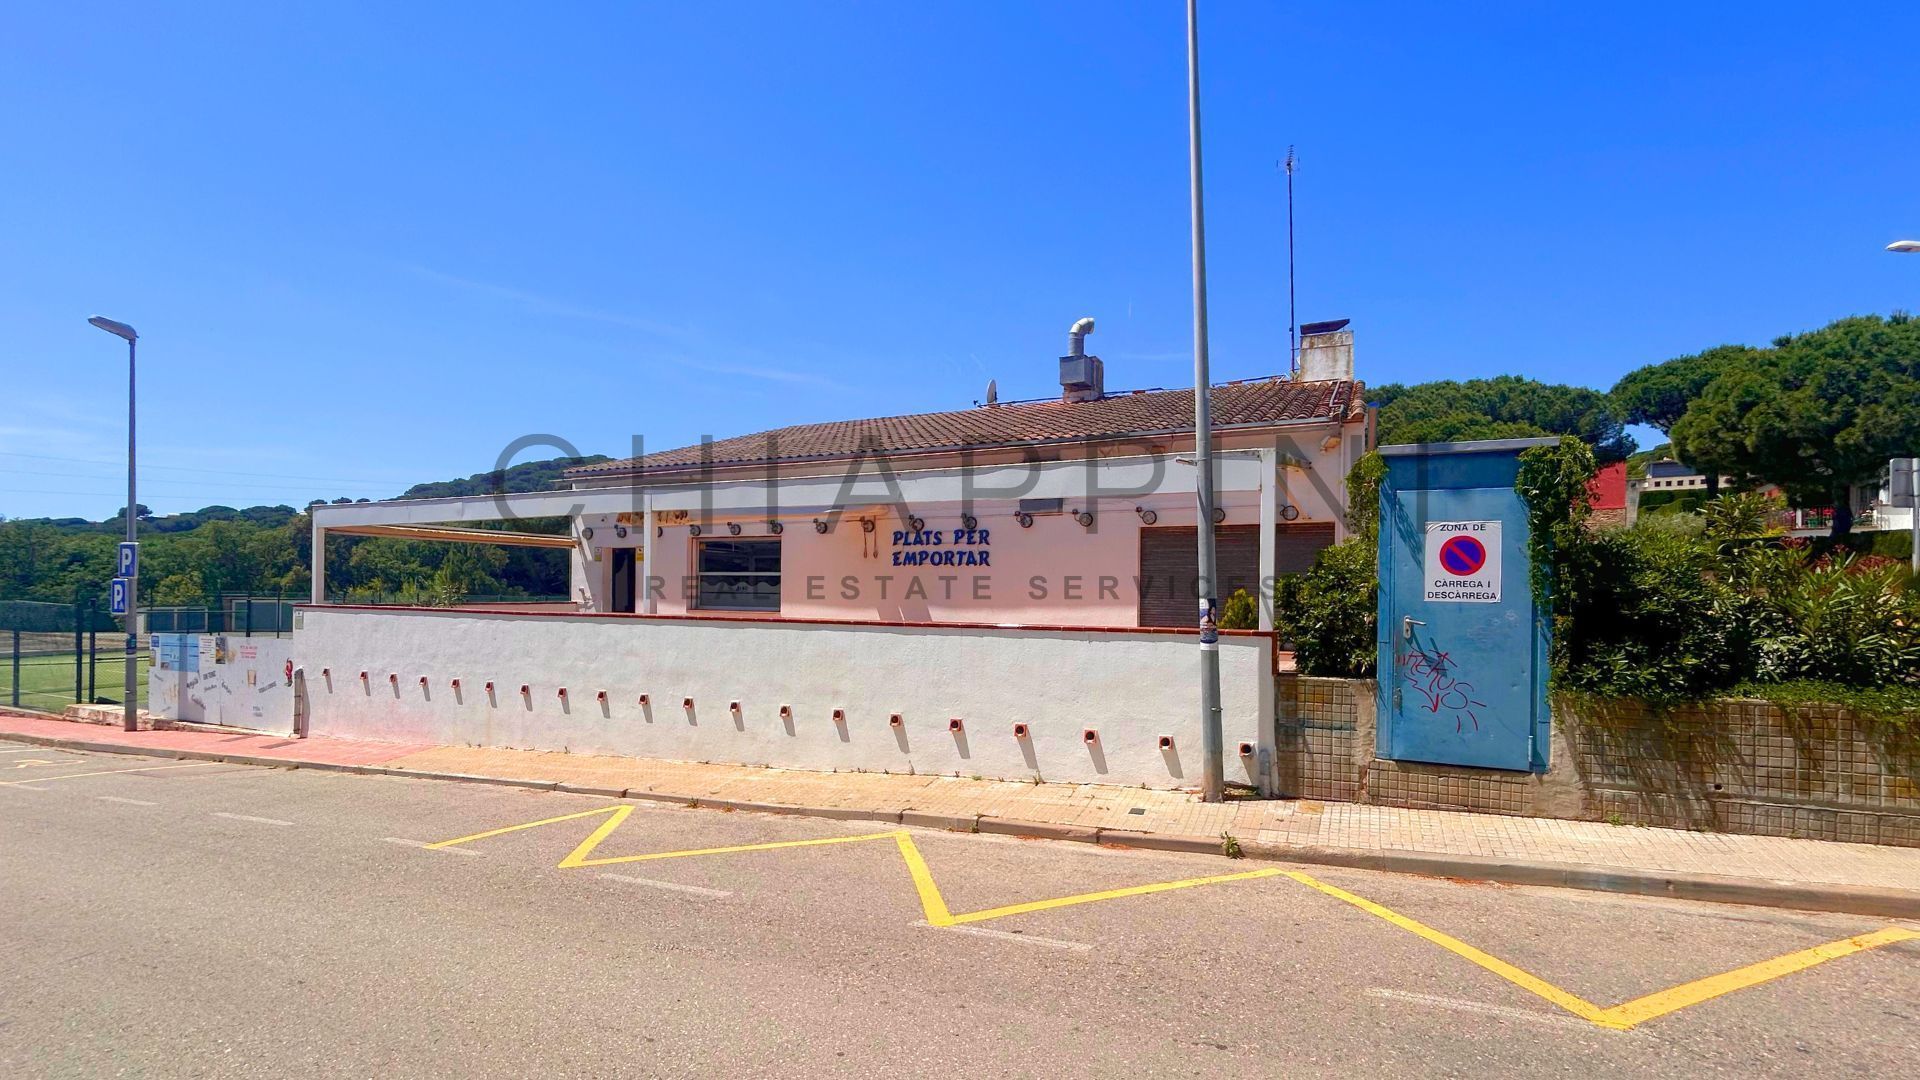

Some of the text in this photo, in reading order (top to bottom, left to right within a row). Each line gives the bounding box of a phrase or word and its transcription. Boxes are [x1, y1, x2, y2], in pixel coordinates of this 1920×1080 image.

[1440, 523, 1487, 532] ZONA DE
[893, 528, 991, 547] PLATS PER
[121, 548, 133, 574] P
[892, 550, 991, 567] EMPORTAR
[1434, 577, 1483, 589] CÀRREGA
[113, 584, 124, 610] P
[1427, 588, 1497, 601] DESCÀRREGA
